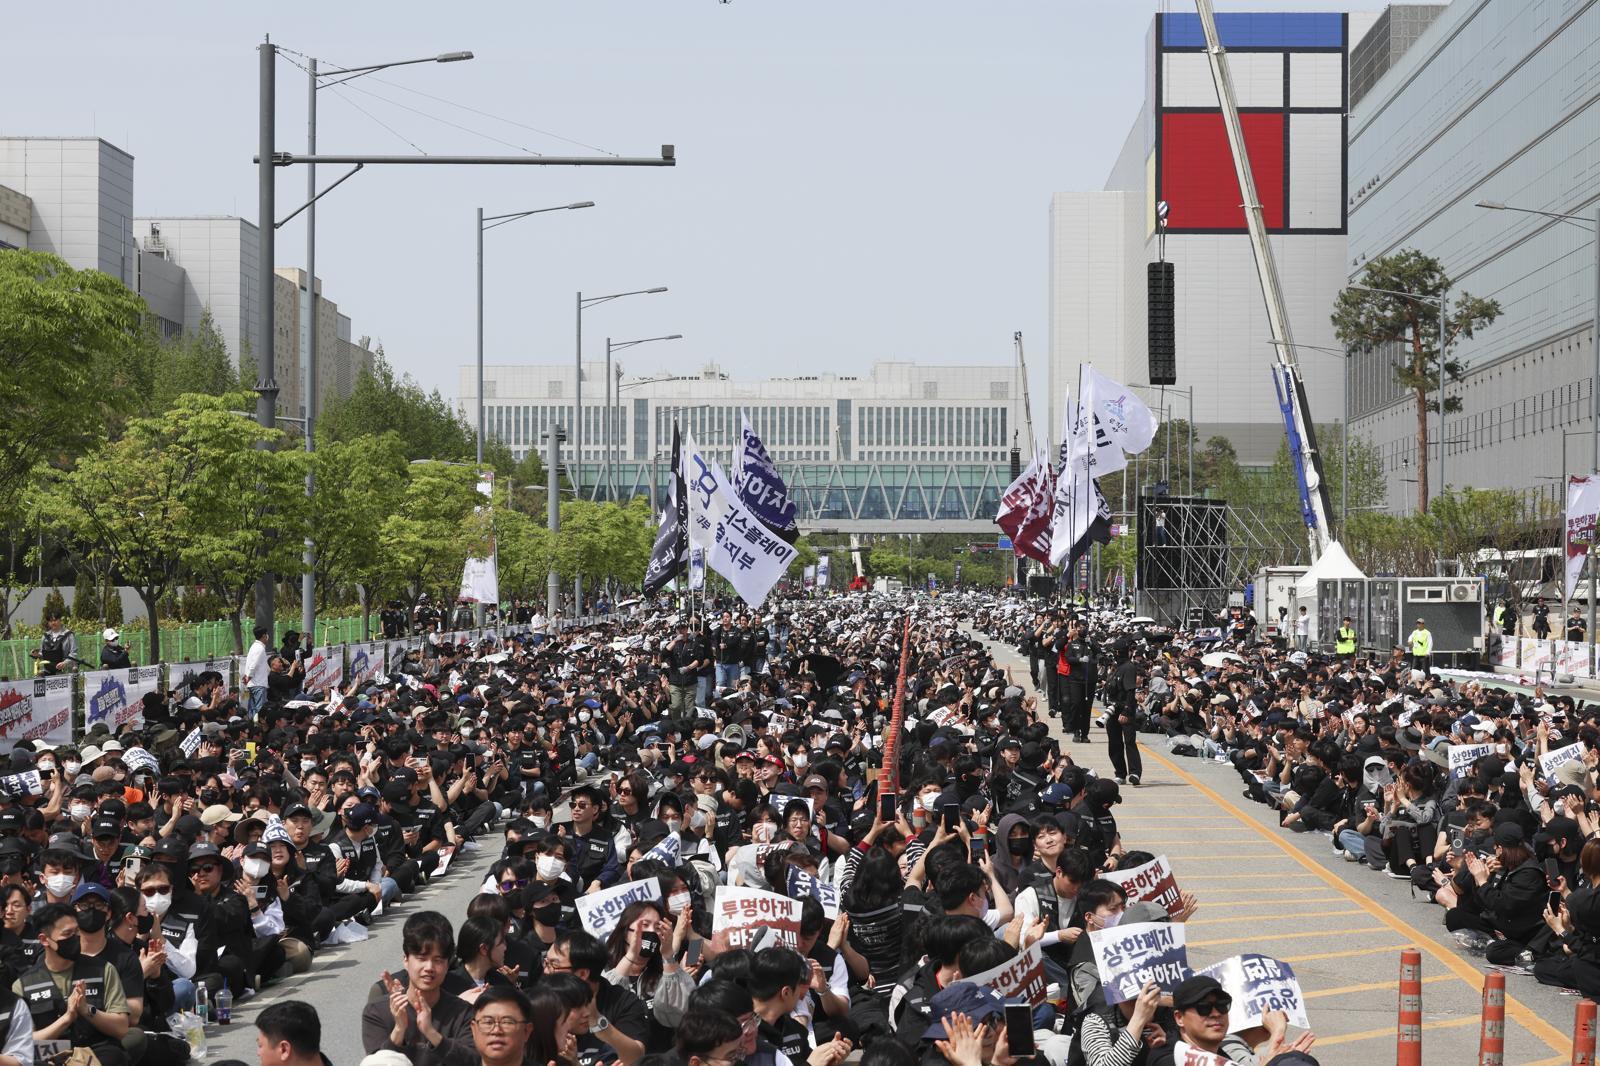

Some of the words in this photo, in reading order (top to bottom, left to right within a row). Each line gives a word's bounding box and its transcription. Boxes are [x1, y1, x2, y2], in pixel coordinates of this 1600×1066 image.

[1452, 745, 1489, 764] 상한폐지
[1544, 744, 1580, 771] 상한폐지
[1120, 861, 1164, 897] 명하게
[588, 882, 652, 929] 상한폐지
[722, 897, 793, 919] 투명하게
[1102, 926, 1175, 967] 상한폐지
[1119, 961, 1185, 1000] 실현하자
